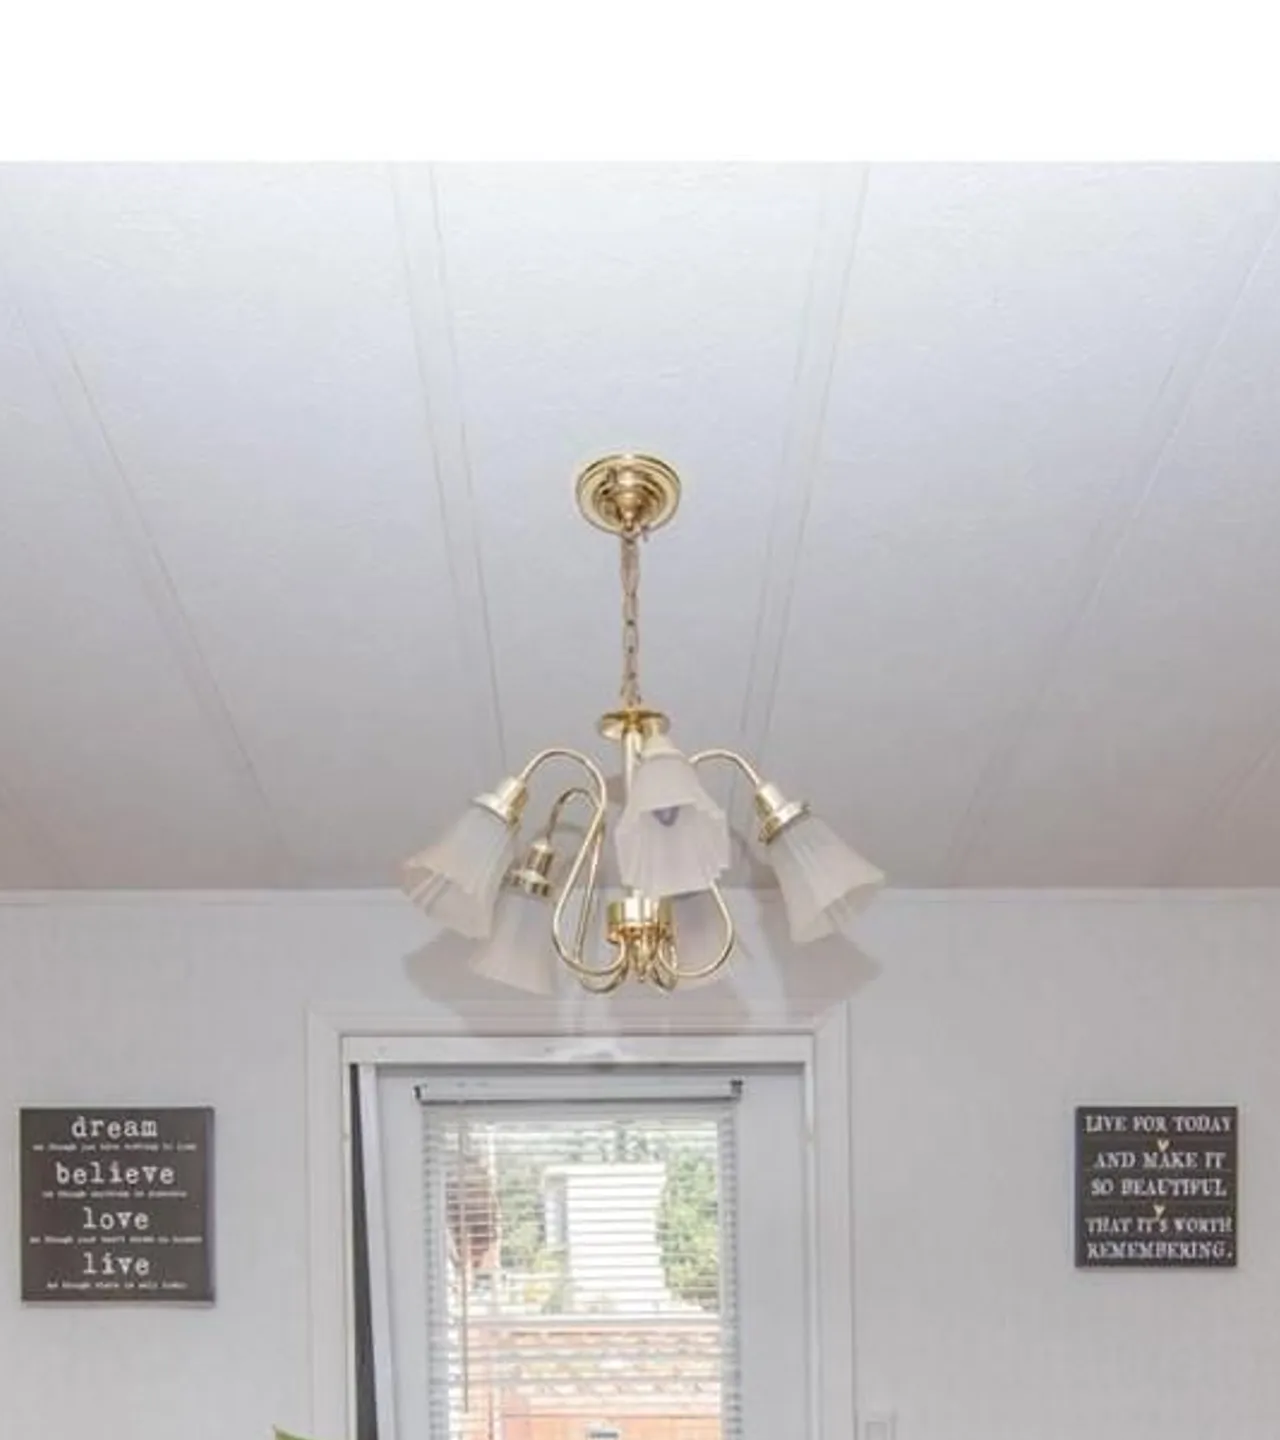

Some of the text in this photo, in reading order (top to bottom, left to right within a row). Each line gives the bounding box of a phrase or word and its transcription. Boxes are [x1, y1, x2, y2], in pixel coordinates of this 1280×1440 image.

[71, 1115, 158, 1138] dream
[1084, 1115, 1233, 1133] LIVE FOR TODAY
[1093, 1151, 1226, 1169] AND MAKE IT
[56, 1161, 174, 1185] believe
[1091, 1178, 1228, 1196] SO BEAUTIFUL
[83, 1206, 150, 1230] love
[1084, 1217, 1133, 1234] THAT
[1173, 1217, 1233, 1234] WORTH
[83, 1252, 150, 1276] live
